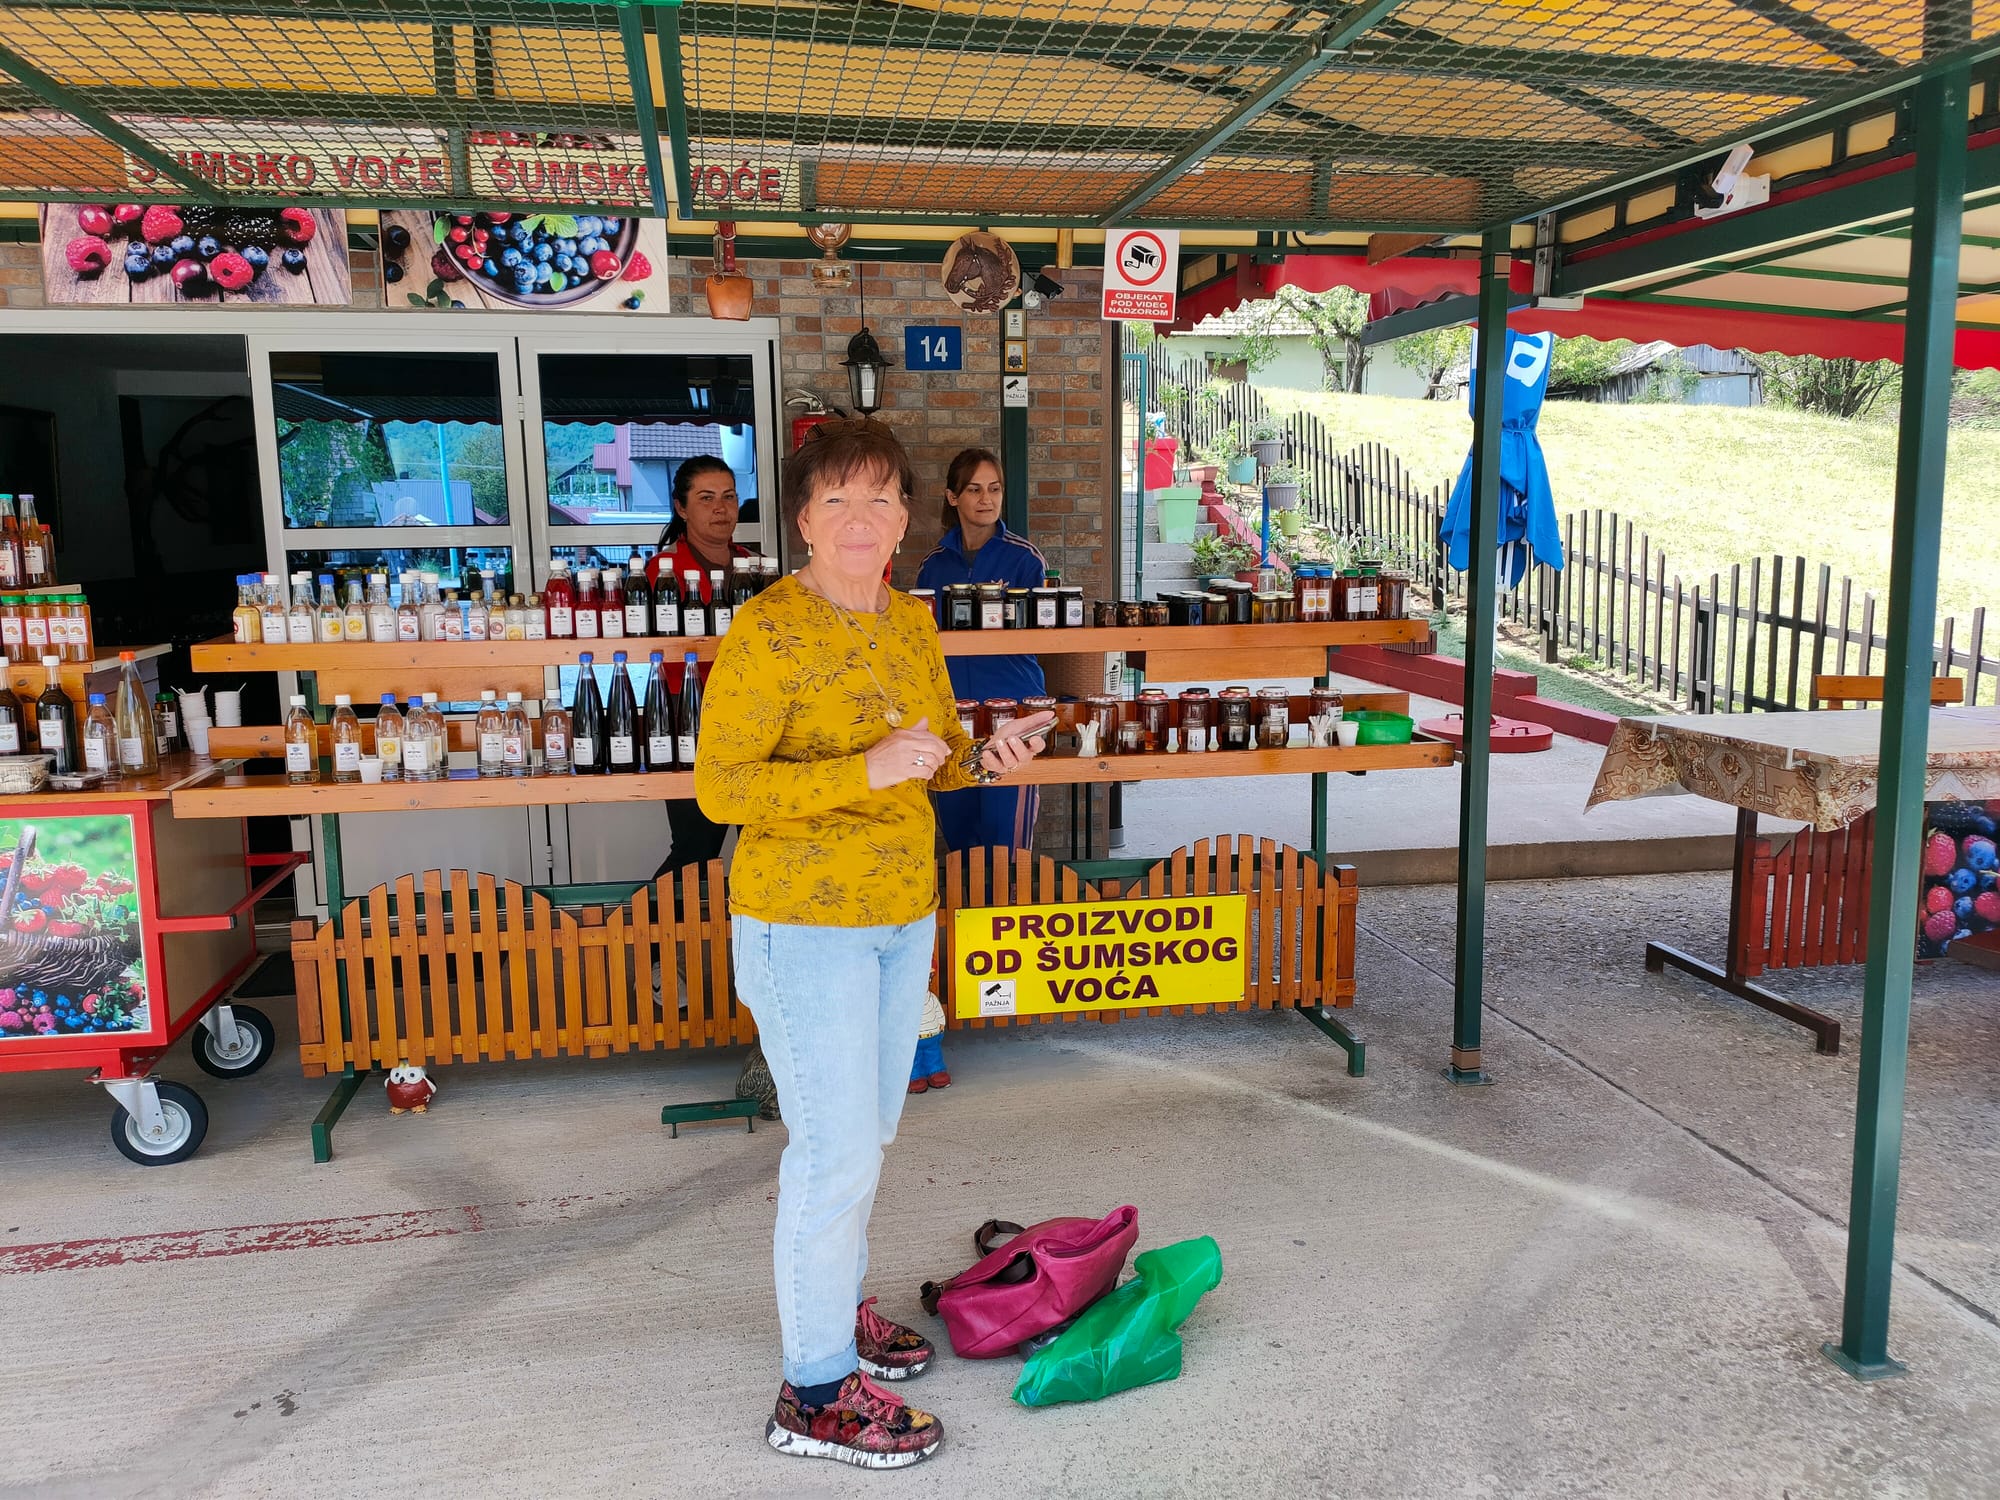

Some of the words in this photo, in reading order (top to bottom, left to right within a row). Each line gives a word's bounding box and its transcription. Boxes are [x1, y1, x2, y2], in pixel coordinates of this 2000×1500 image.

[332, 147, 442, 190] VOĆE
[1108, 307, 1169, 316] NADZOROM
[1110, 299, 1133, 307] POD
[1136, 301, 1167, 309] VIDEO
[1115, 292, 1164, 301] OBJEKAT
[920, 335, 949, 363] 14
[992, 905, 1213, 941] PROIZVODI
[965, 949, 1022, 976] OD
[1037, 936, 1238, 972] ŠUMSKOG
[1047, 970, 1160, 1004] VOĆA
